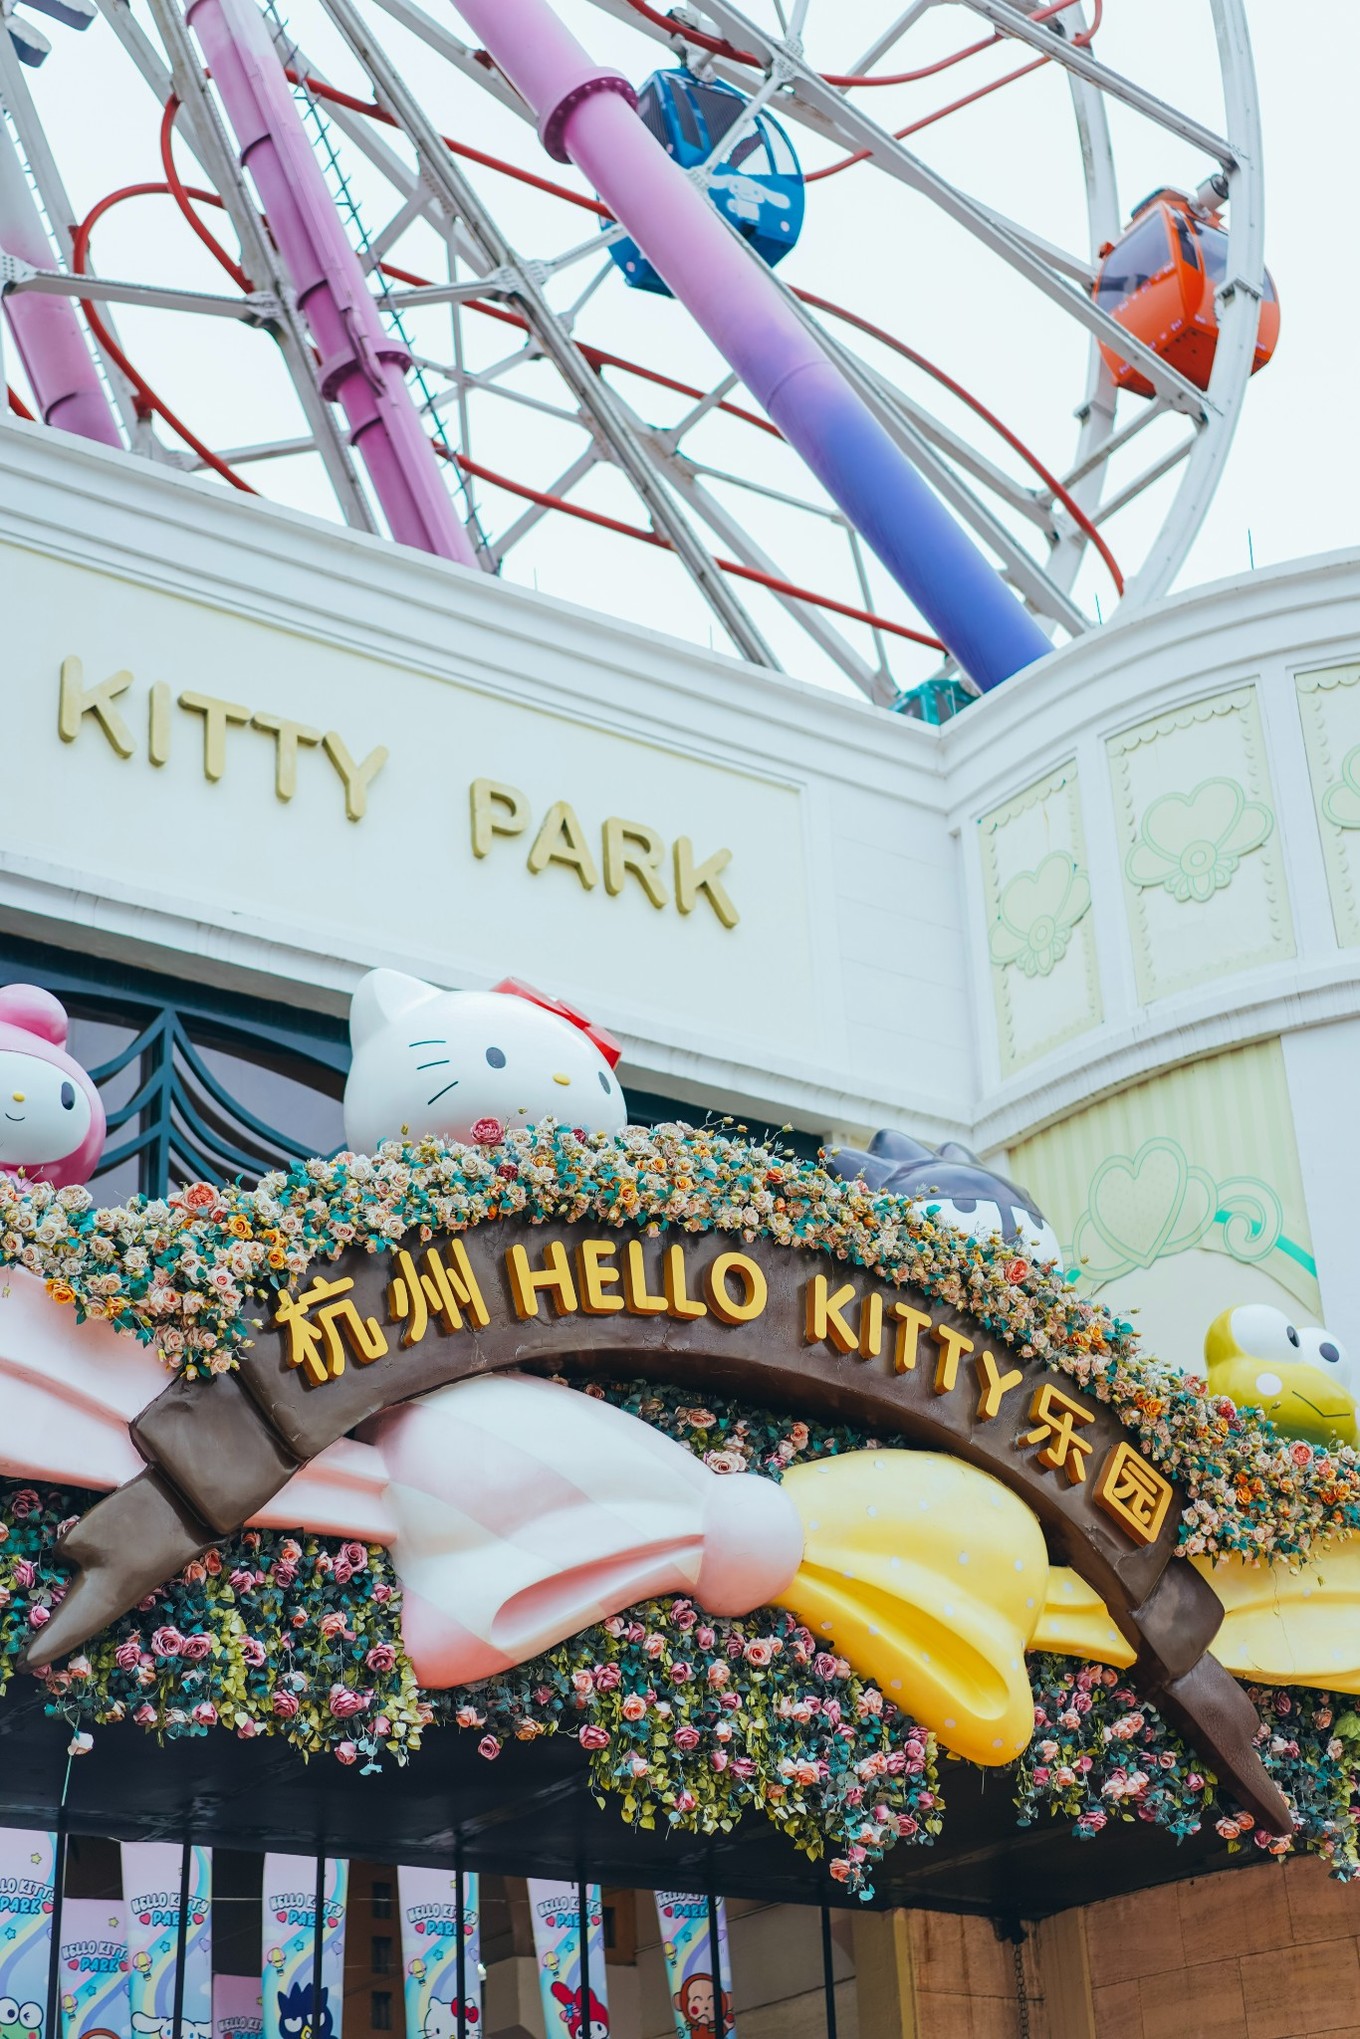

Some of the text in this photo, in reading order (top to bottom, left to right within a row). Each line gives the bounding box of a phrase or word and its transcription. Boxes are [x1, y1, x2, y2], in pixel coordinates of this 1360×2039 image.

[58, 654, 741, 929] KITTY PARK
[274, 1238, 1174, 1547] 杭州 HELLO KITTY 乐园
[0, 1896, 41, 1914] PARK
[131, 1892, 168, 1914] HELLO
[270, 1893, 305, 1911] HELLO
[536, 1896, 569, 1918] HELLO
[289, 1909, 325, 1928] PAR
[407, 1903, 441, 1924] HELLO
[556, 1912, 590, 1928] PAR
[61, 1940, 128, 1961] HELLO KITT
[80, 1957, 119, 1973] PARK
